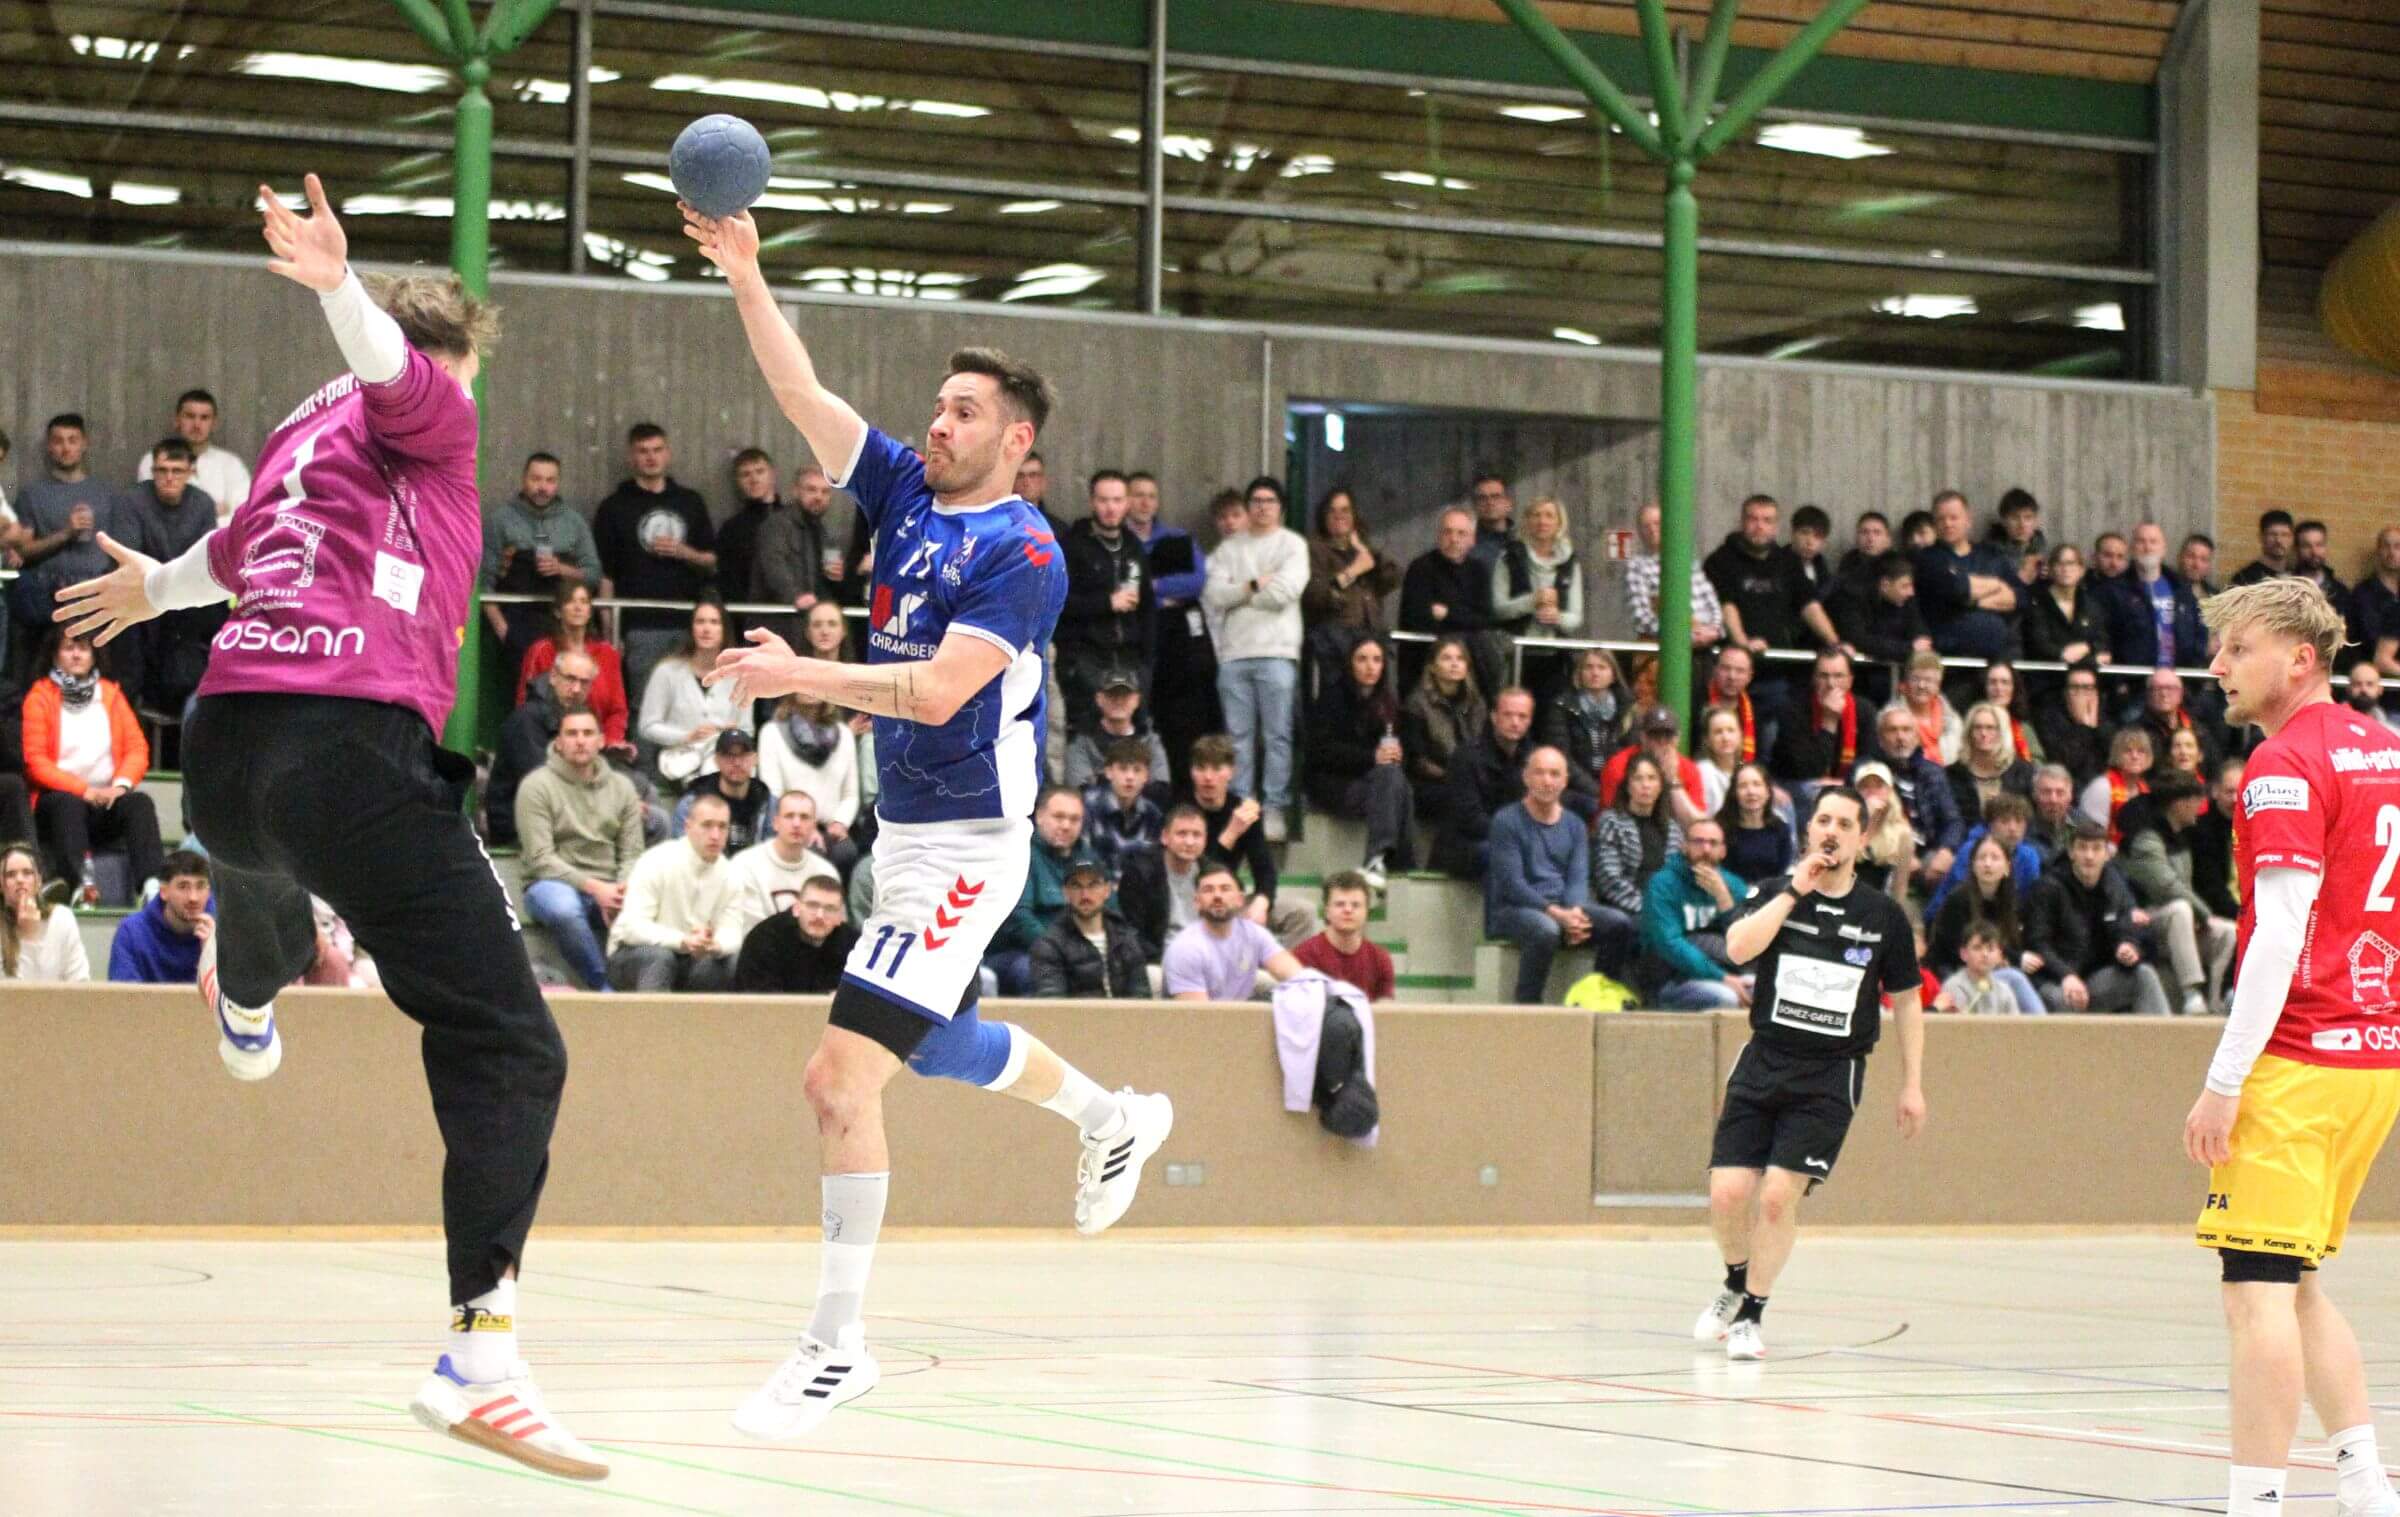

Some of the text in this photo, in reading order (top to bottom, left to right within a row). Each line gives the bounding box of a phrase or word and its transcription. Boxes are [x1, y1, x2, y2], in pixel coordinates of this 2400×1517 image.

[275, 424, 328, 513] 1
[218, 620, 365, 656] osann
[870, 632, 937, 659] CHRAMBER
